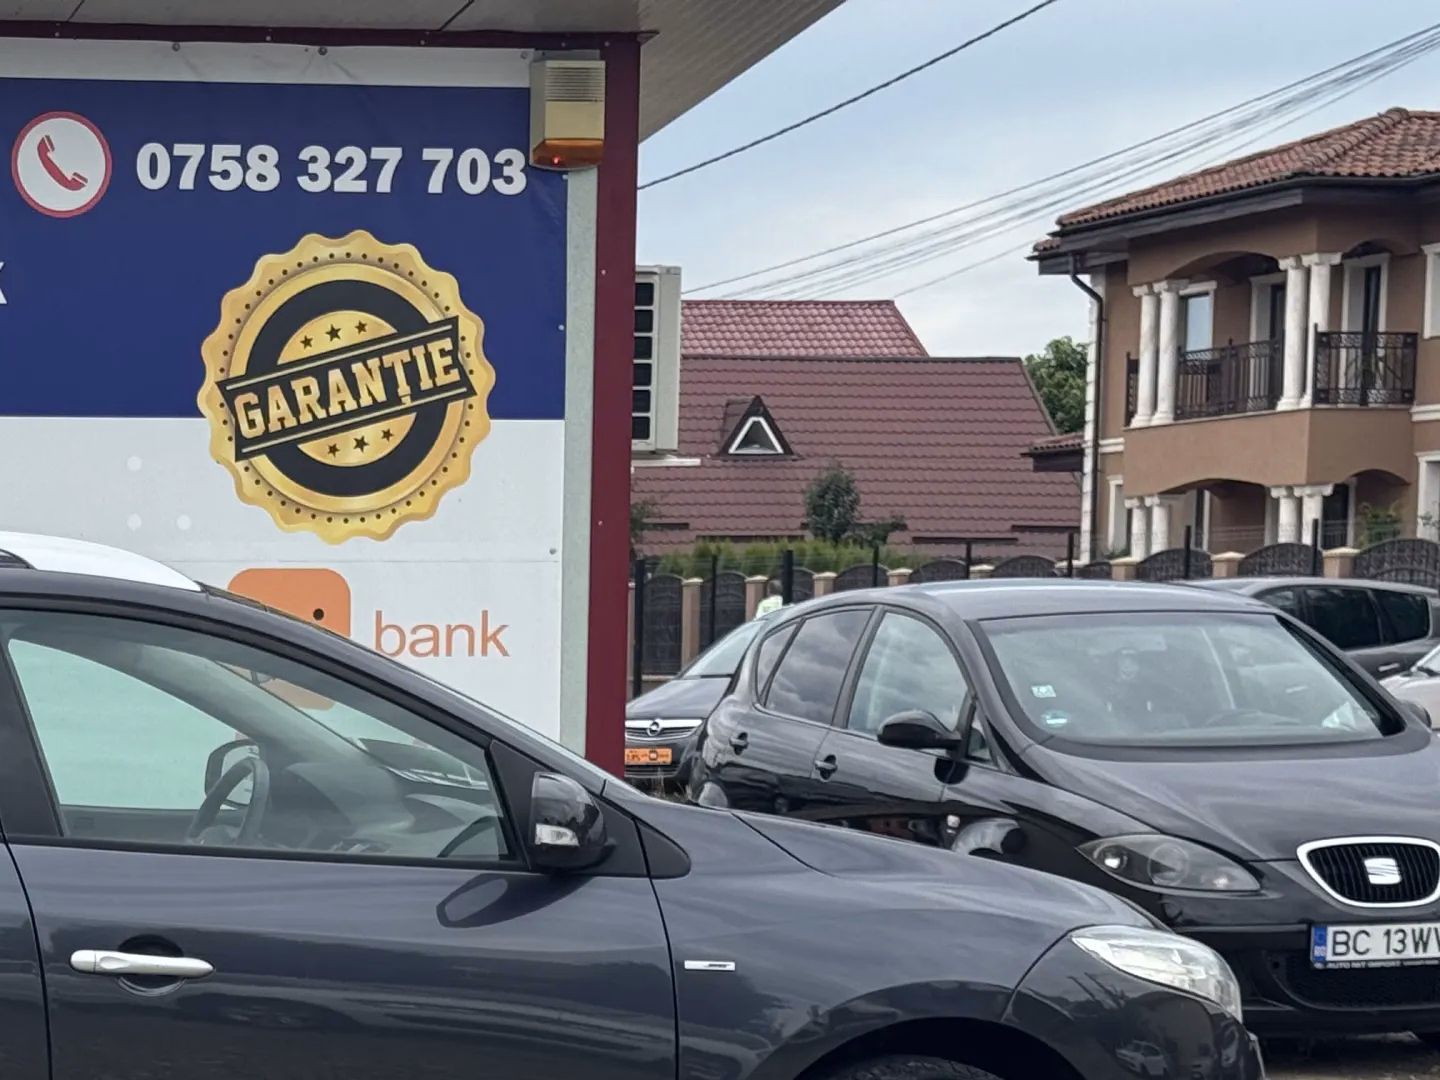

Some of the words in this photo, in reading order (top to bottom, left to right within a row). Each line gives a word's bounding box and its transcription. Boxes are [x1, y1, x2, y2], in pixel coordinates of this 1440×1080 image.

[136, 142, 281, 192] 0758
[296, 145, 403, 194] 327
[421, 147, 527, 196] 703
[375, 610, 510, 657] bank
[1332, 929, 1371, 956] BC
[1383, 928, 1407, 954] 13
